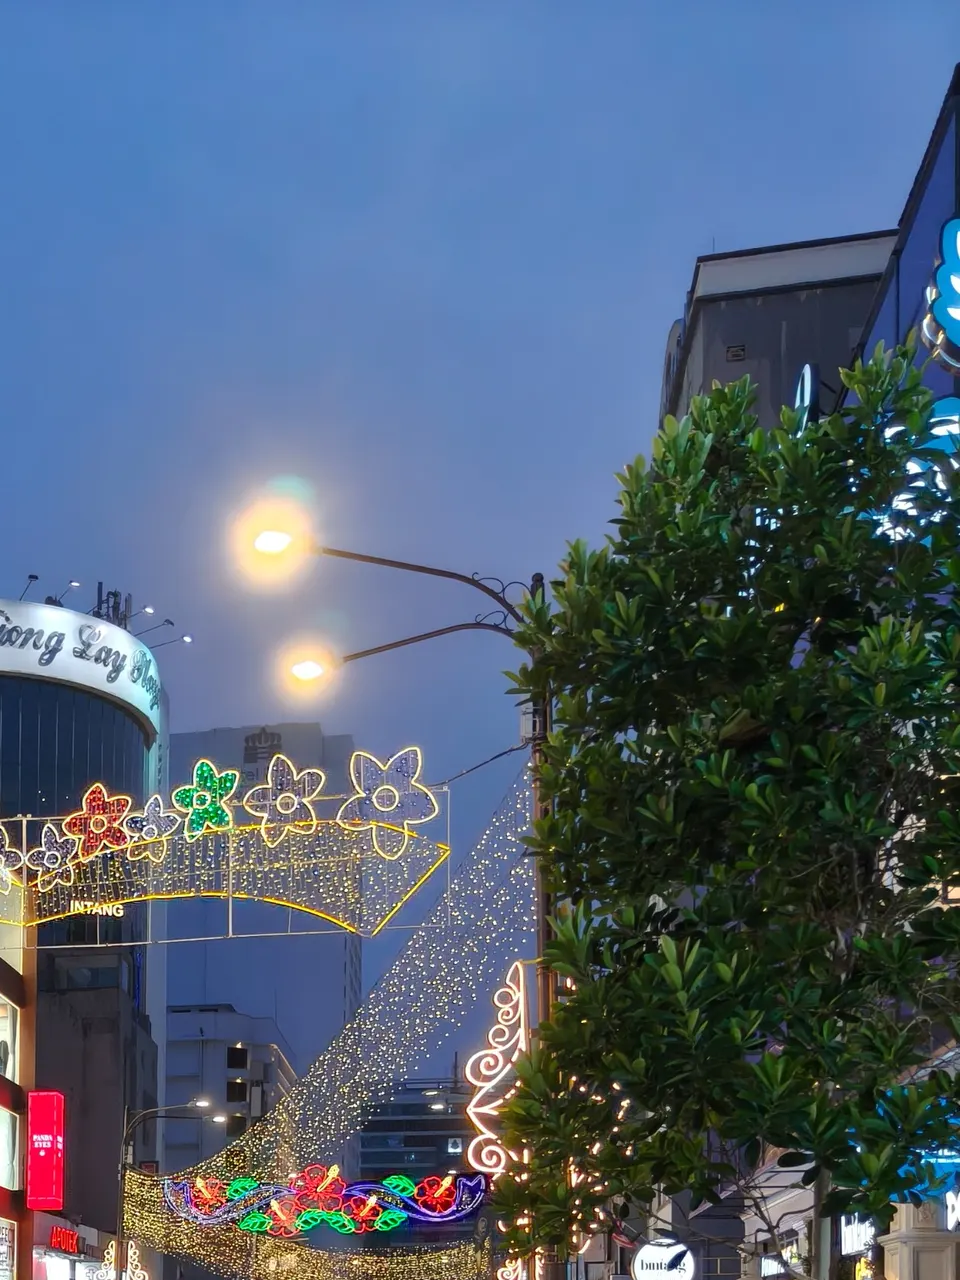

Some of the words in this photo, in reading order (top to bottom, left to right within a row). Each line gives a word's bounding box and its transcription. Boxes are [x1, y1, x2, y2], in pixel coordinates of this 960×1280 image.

[73, 624, 127, 683] Lay
[32, 1134, 53, 1142] PANDA
[34, 1141, 52, 1149] EYES
[51, 1226, 79, 1253] APOTEK
